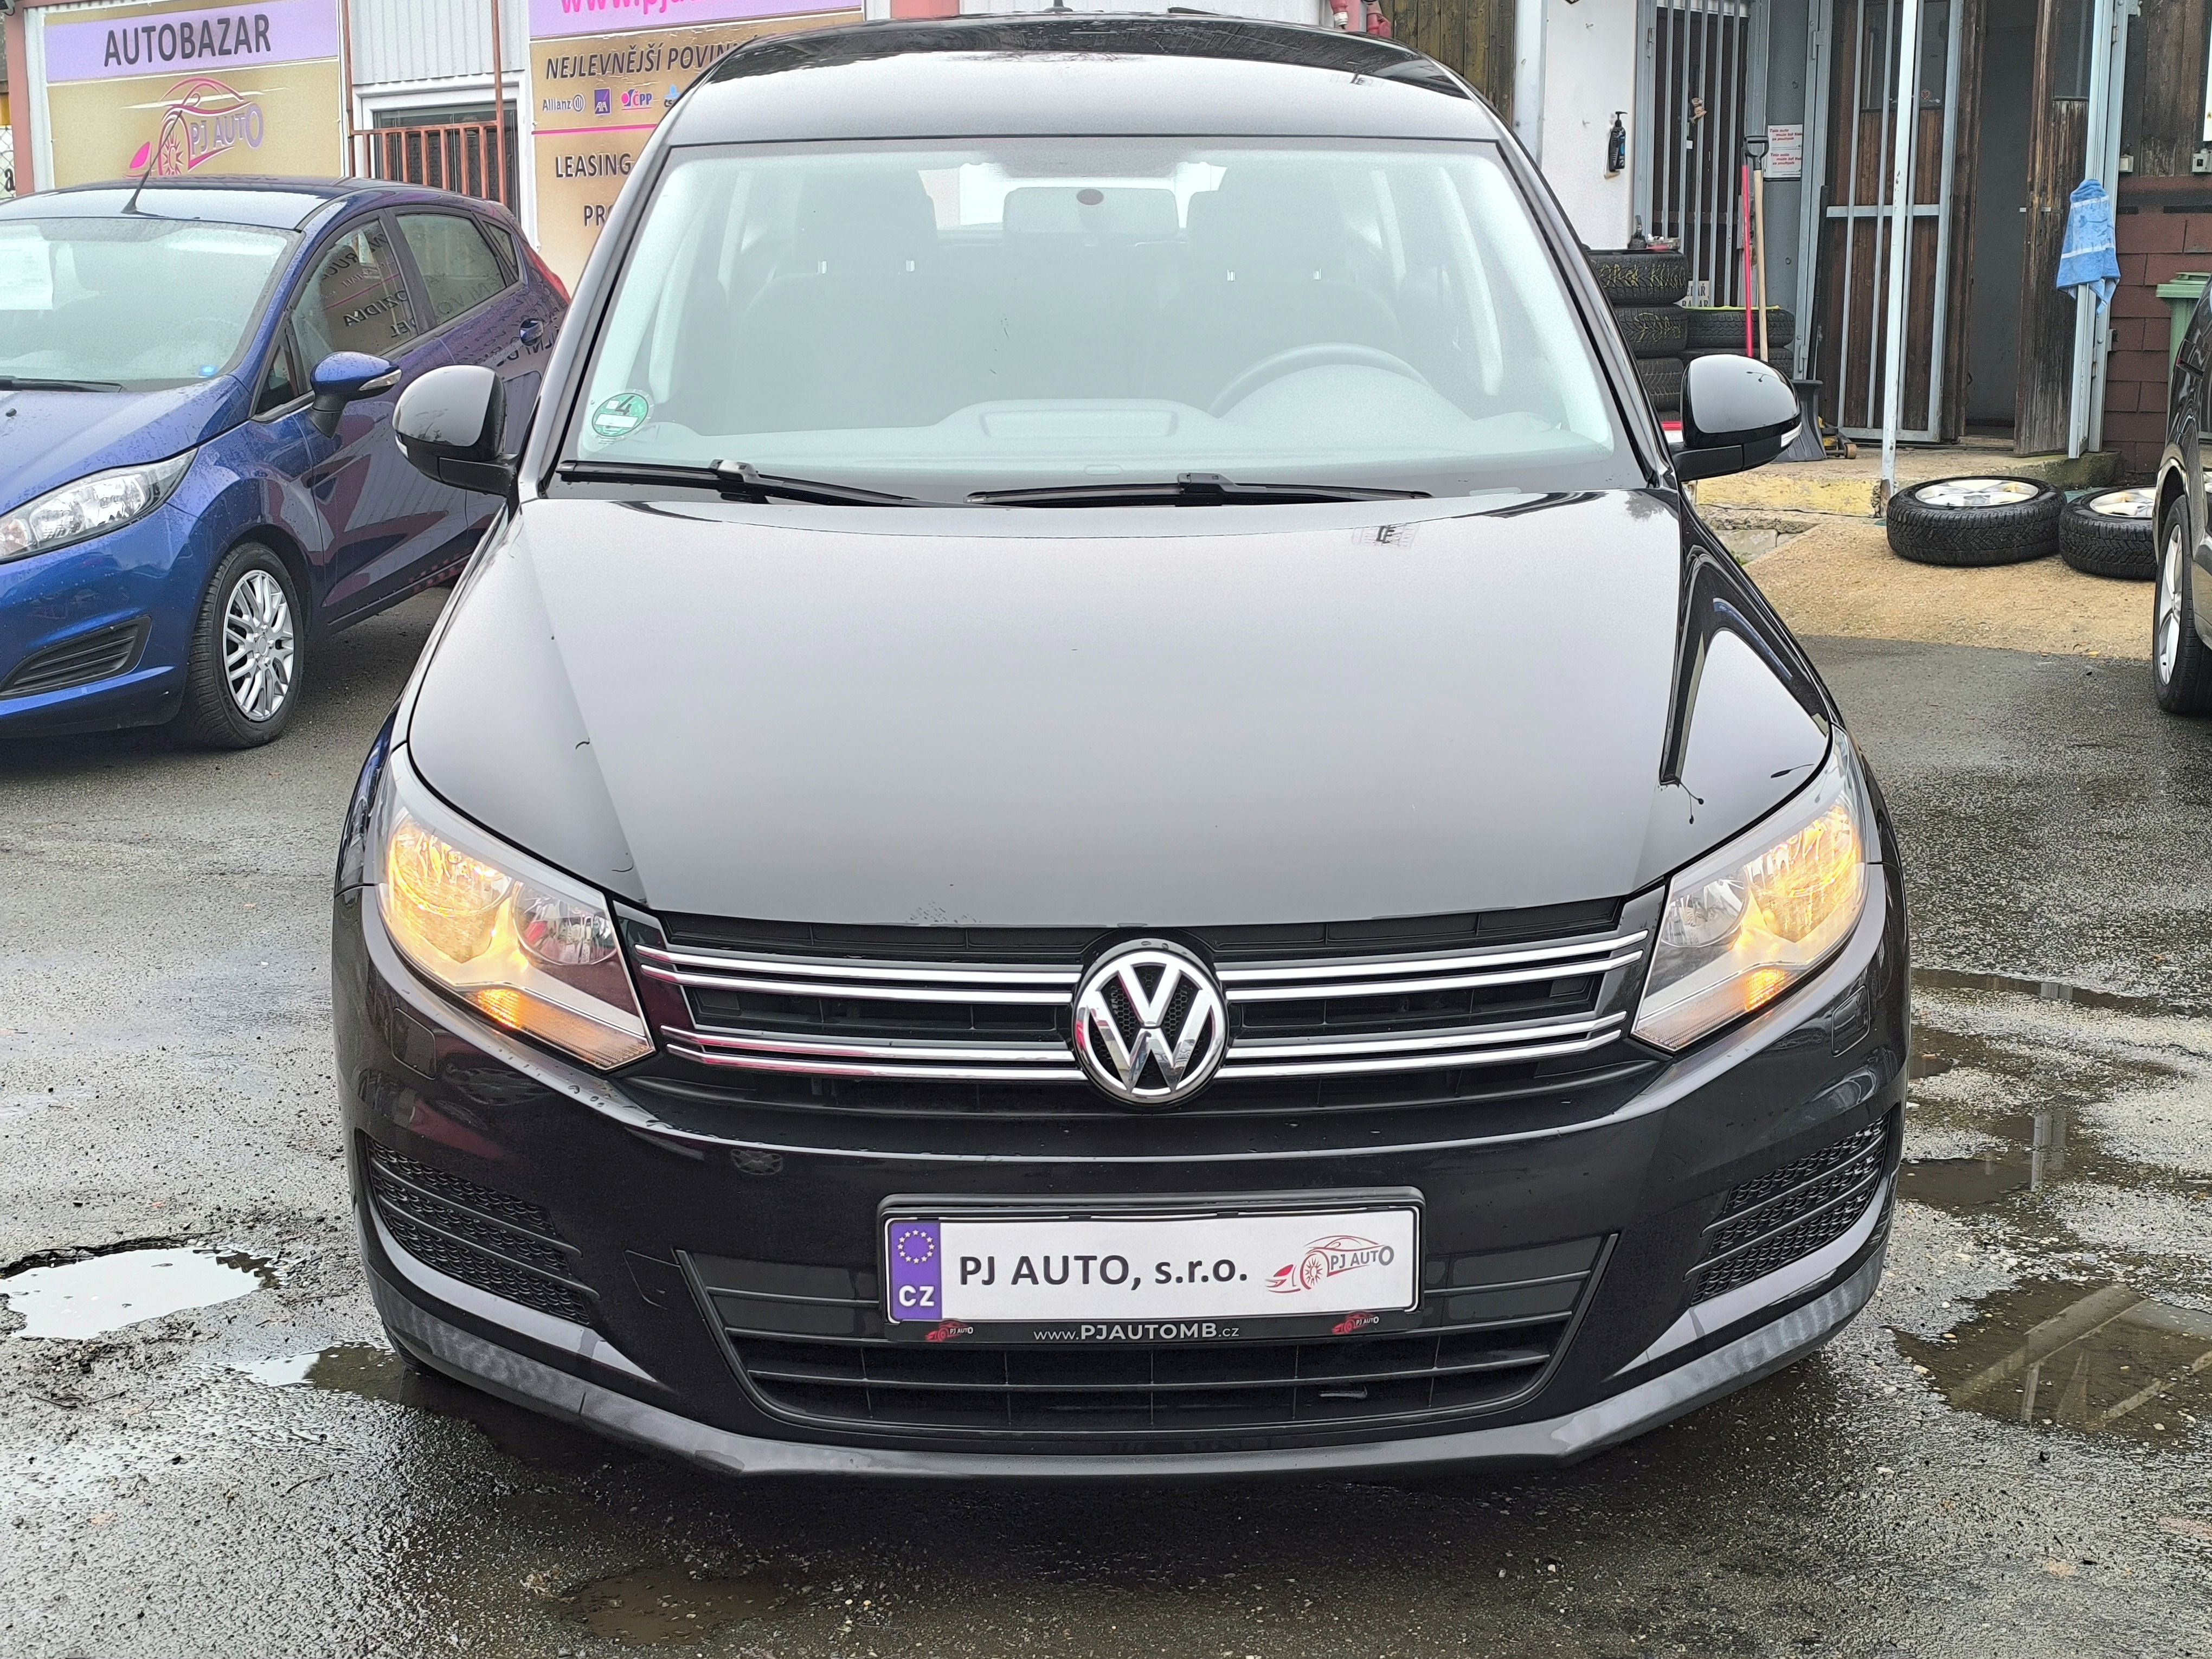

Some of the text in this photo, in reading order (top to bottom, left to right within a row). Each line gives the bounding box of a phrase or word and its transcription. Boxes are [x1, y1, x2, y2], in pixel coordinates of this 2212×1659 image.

[104, 14, 271, 67] AUTOBAZAR
[546, 42, 664, 80] NEJLEVNĚJŠÍ
[633, 90, 652, 106] ČPP
[190, 103, 264, 157] PJ AUTO
[556, 153, 631, 178] LEASING
[584, 204, 613, 227] PR
[1330, 1245, 1394, 1270] PJ AUTO
[960, 1255, 1247, 1291] PJ AUTO, s.r.o.
[898, 1285, 935, 1307] CZ
[957, 1326, 974, 1334] AUTO
[1033, 1322, 1240, 1341] www.PJAUTOMB.cz
